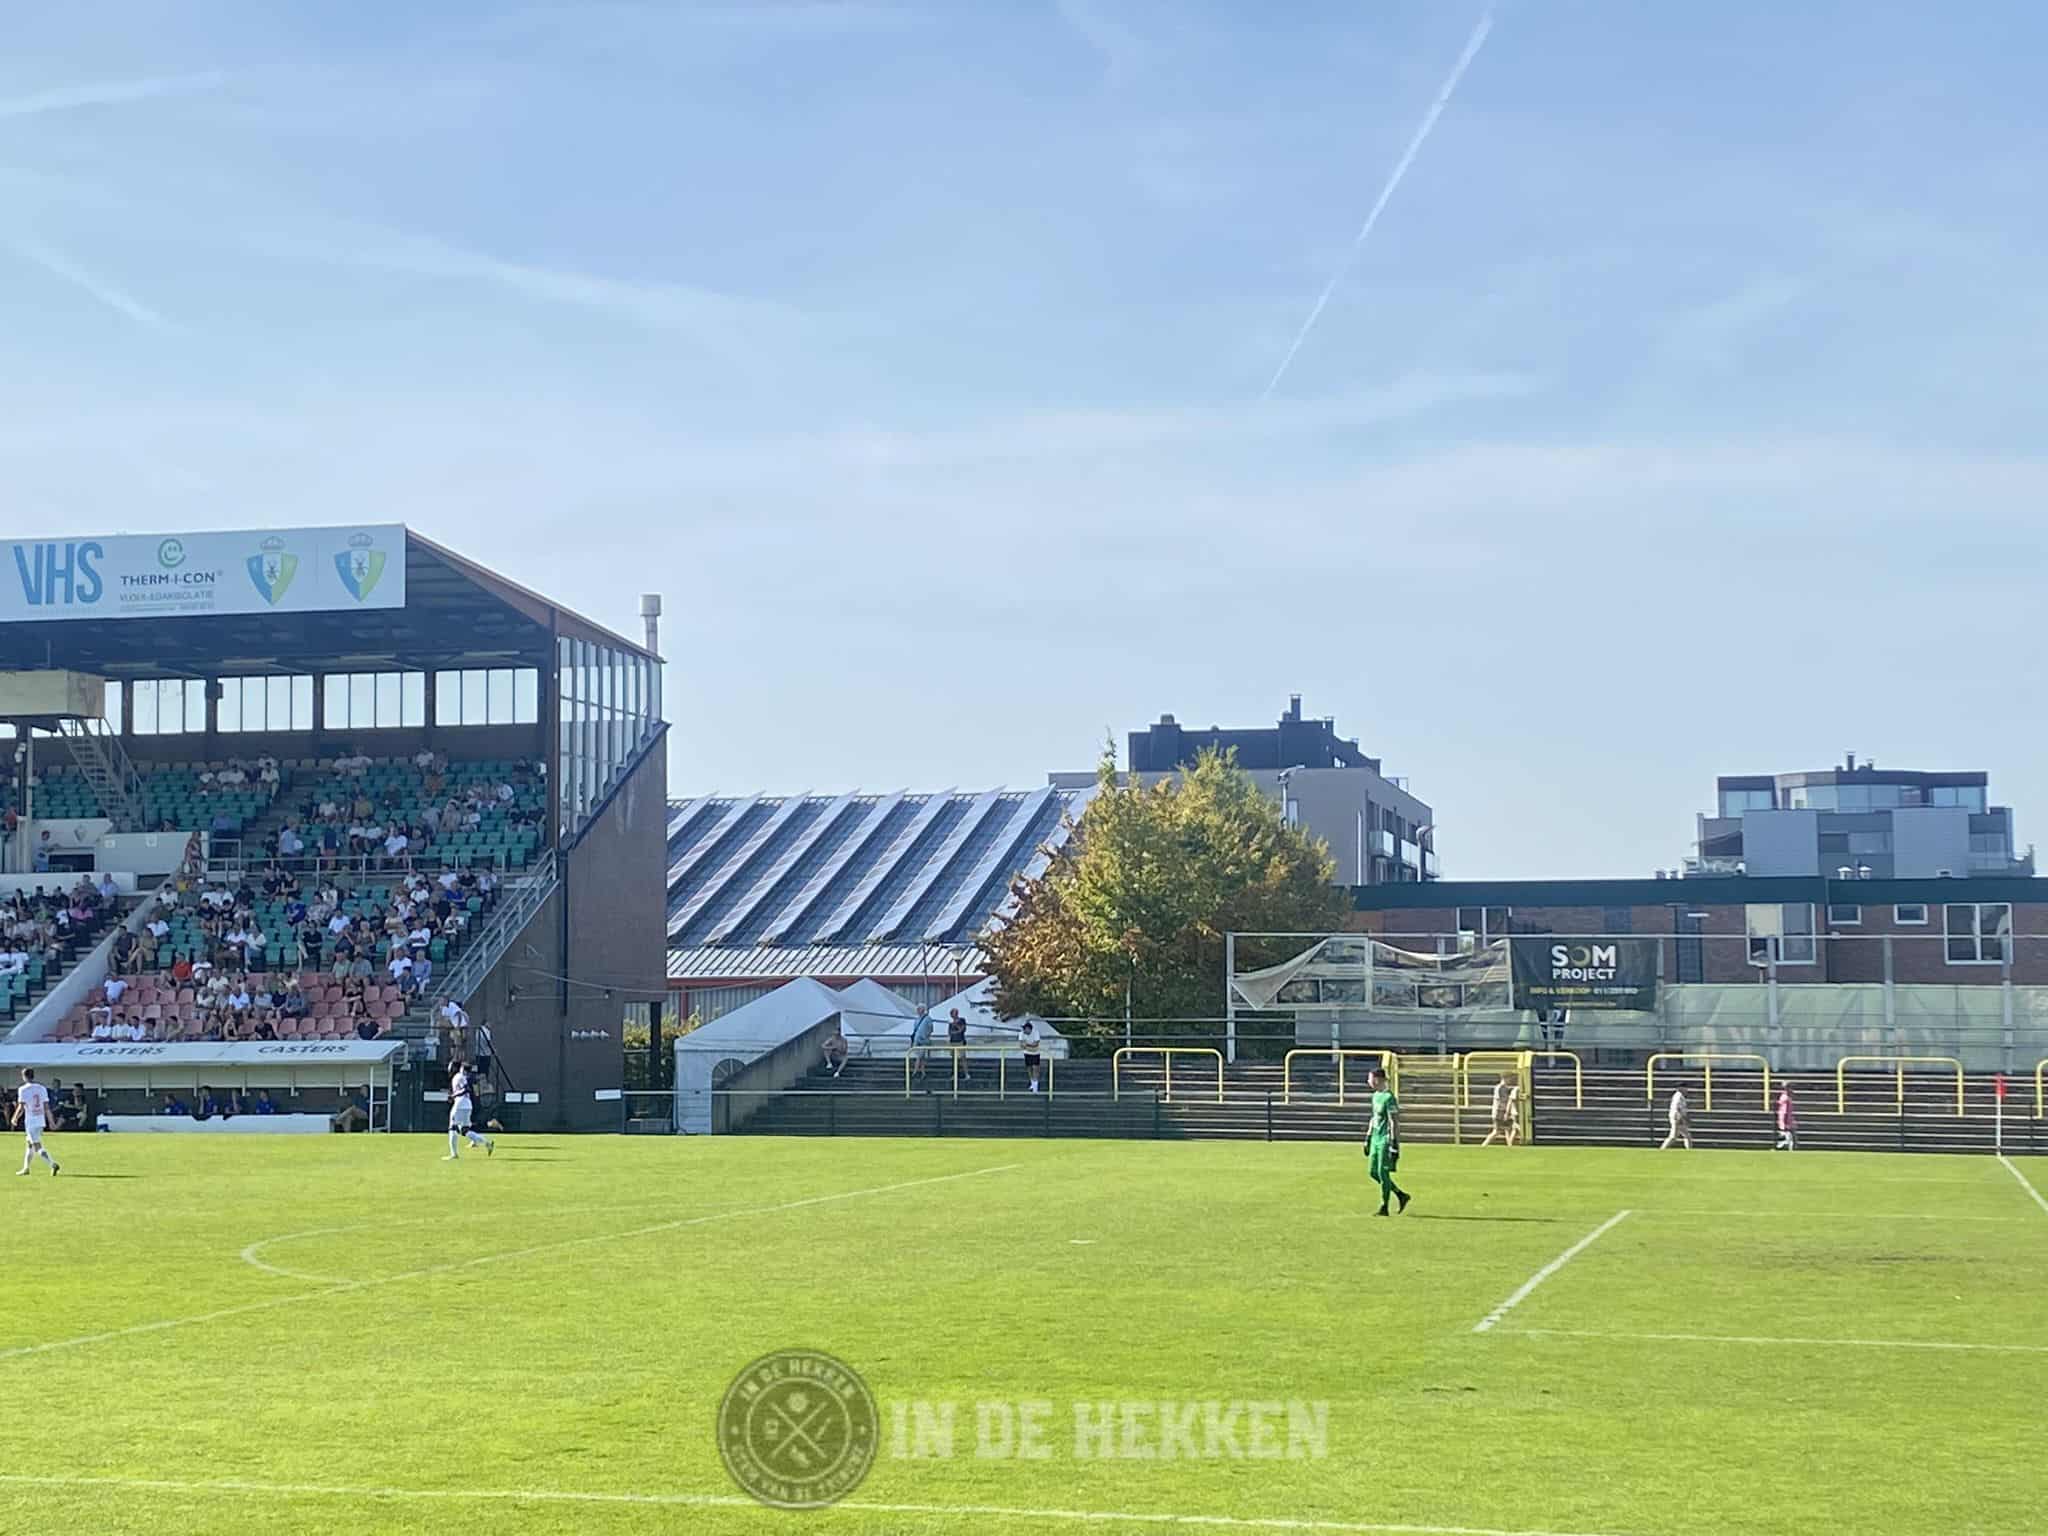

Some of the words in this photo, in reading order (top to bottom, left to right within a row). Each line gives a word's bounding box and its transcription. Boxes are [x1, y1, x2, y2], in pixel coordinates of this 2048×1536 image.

[13, 542, 104, 605] VHS
[1551, 945, 1616, 967] SOM
[1552, 968, 1616, 981] PROJECT
[78, 1047, 166, 1056] CASTERS
[258, 1045, 348, 1053] CASTERS
